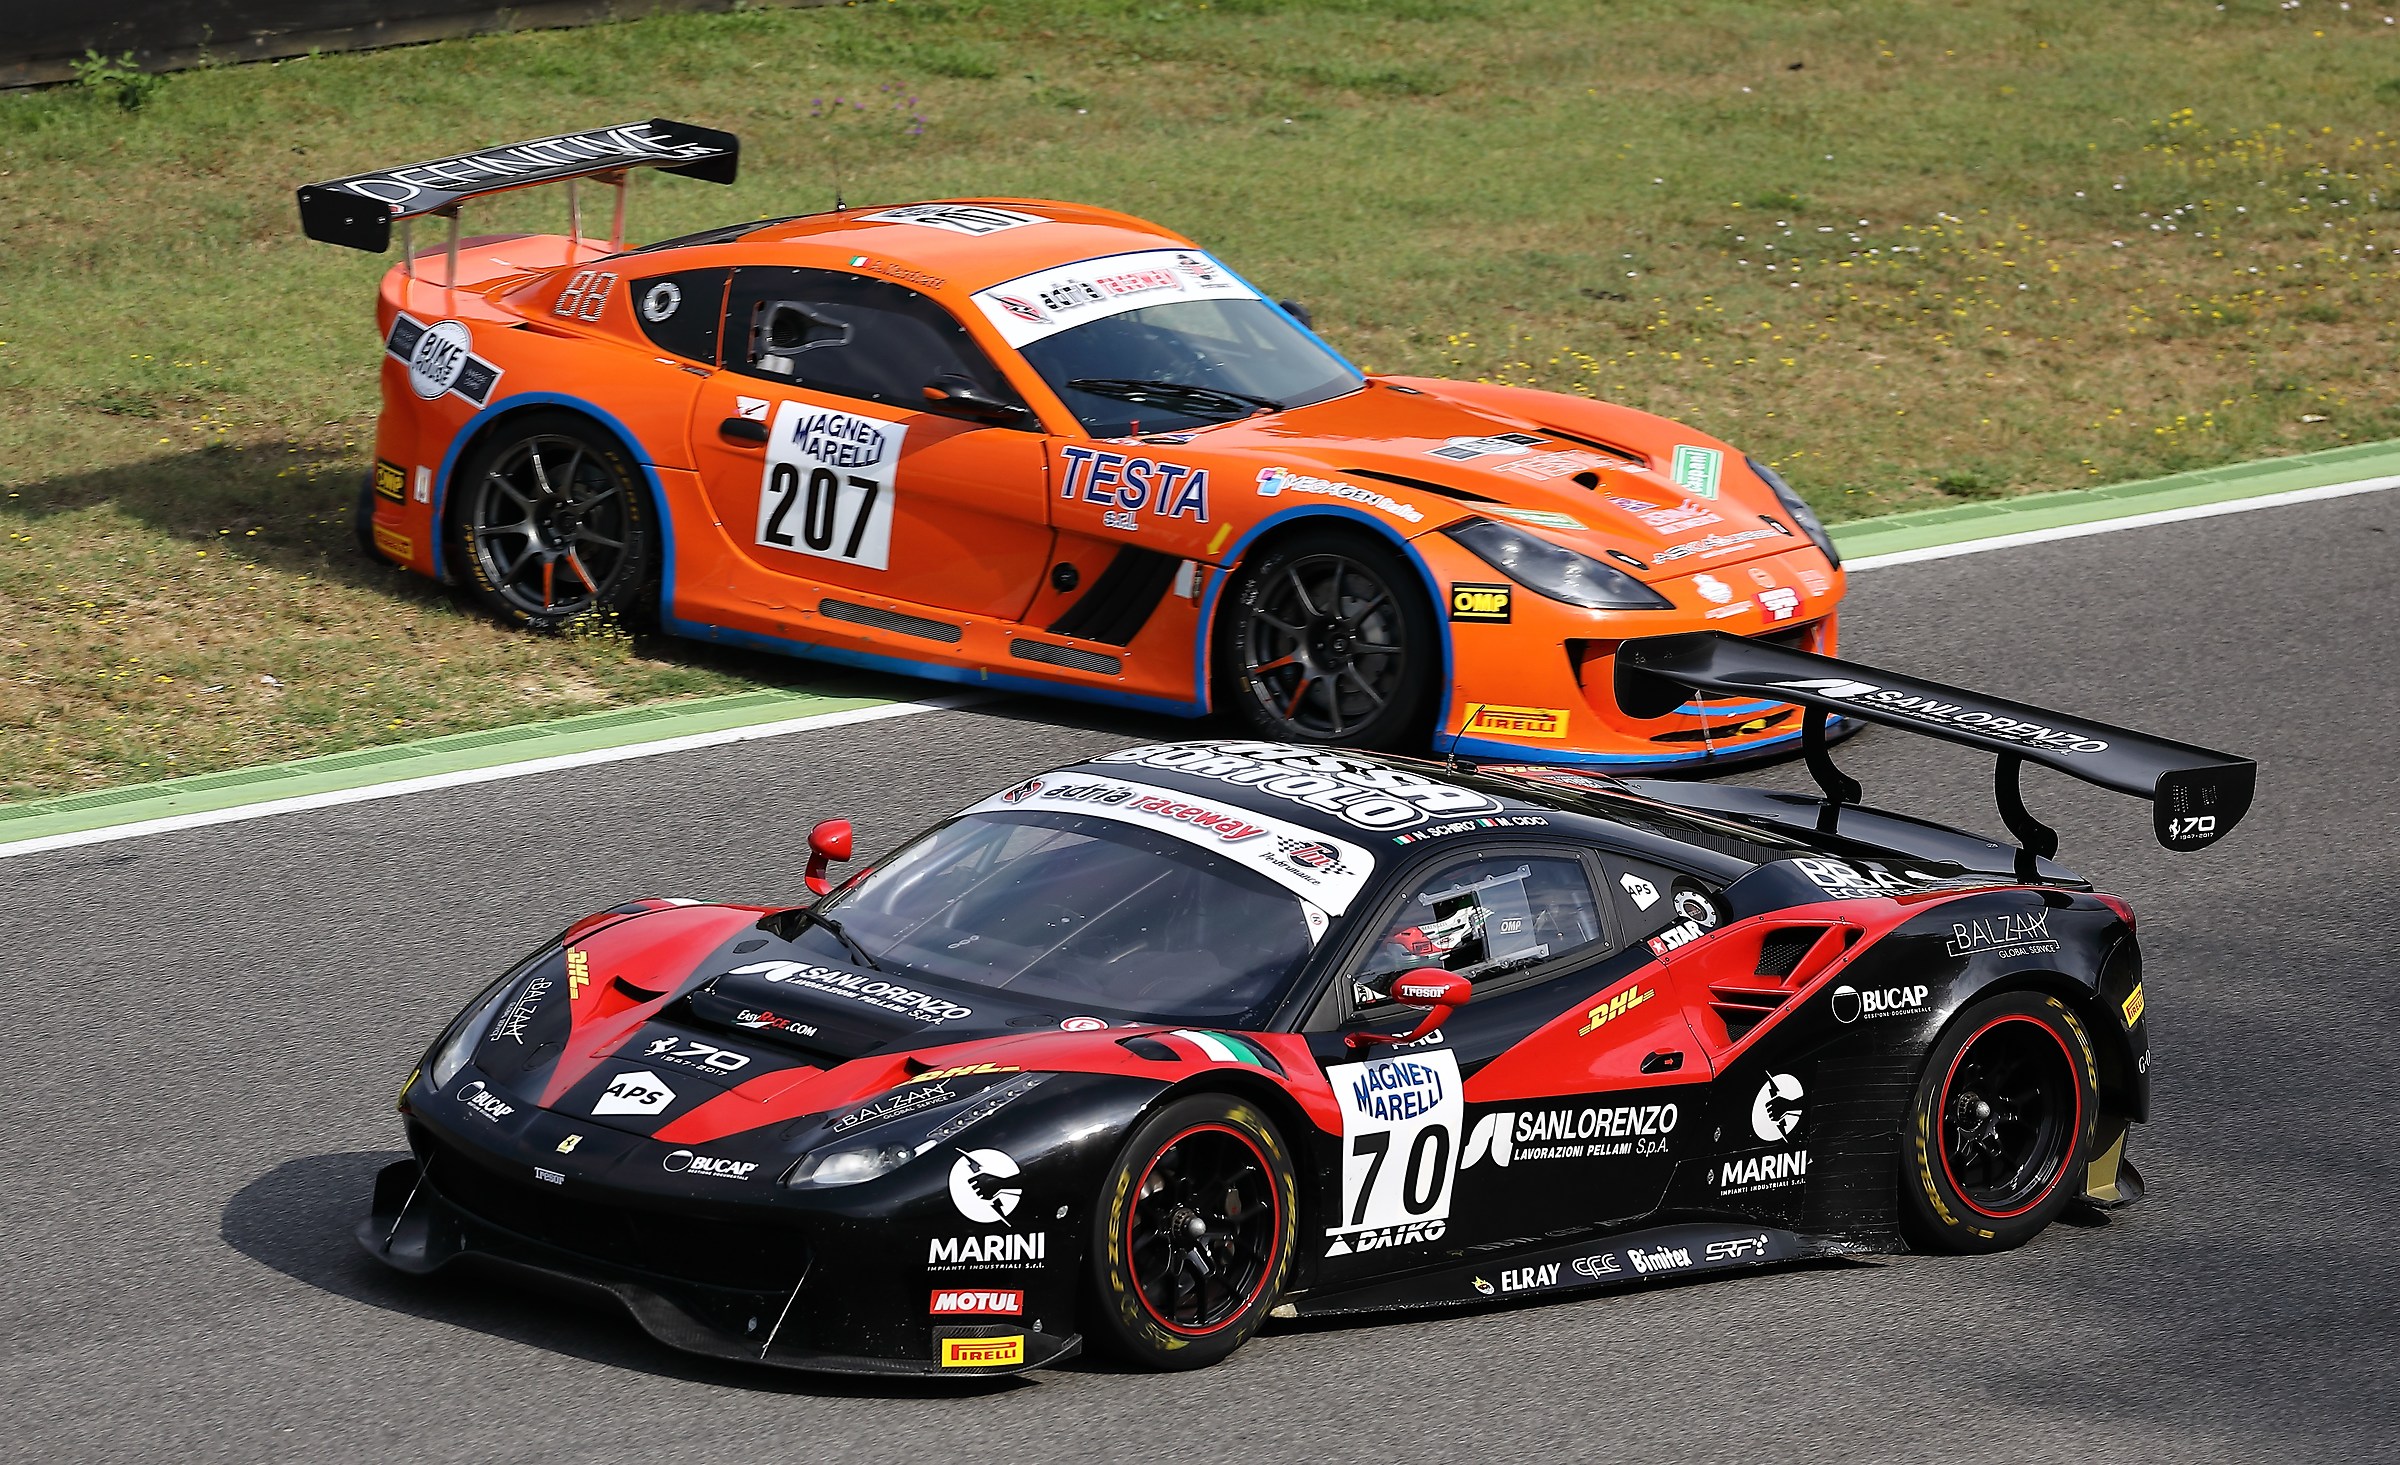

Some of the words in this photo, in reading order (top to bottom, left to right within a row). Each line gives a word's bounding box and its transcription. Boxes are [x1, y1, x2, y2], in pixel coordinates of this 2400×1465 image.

[343, 124, 699, 203] DEFINITIVE
[421, 332, 464, 371] BIKE
[793, 413, 886, 448] MAGNETI
[800, 430, 884, 467] MARELLI
[1061, 446, 1209, 523] TESTA
[764, 463, 880, 558] 207
[1454, 592, 1508, 612] OMP
[1475, 710, 1557, 733] PIRELLI
[1865, 691, 2109, 753] SANLORENZO
[1101, 746, 1417, 826] BORTOLO
[1046, 782, 1134, 804] adria
[1130, 796, 1267, 841] raceway
[1498, 817, 1513, 827] M.
[1514, 816, 1549, 826] CIOCI
[2182, 815, 2216, 834] 70
[1412, 831, 1429, 841] N.
[1628, 884, 1651, 897] APS
[1500, 920, 1521, 933] OMP
[1664, 921, 1705, 950] STAR
[1953, 907, 2048, 950] BALZAN
[1999, 947, 2029, 959] GLOBAL
[2030, 945, 2056, 955] SERVICE
[786, 977, 857, 999] LAVORAZIONI
[857, 995, 908, 1013] PELLAMI
[799, 966, 973, 1019] SANLORENZO
[1401, 984, 1449, 998] Tresor
[1862, 985, 1928, 1012] BUCAP
[502, 981, 553, 1044] BALZAN
[1584, 985, 1650, 1032] DHL
[670, 1041, 751, 1071] 70
[905, 1062, 1008, 1085] DHL
[1353, 1062, 1443, 1105] MAGNETI
[472, 1091, 514, 1117] BUCAP
[606, 1082, 664, 1106] APS
[842, 1078, 951, 1126] BALZAN
[883, 1106, 915, 1120] GLOBAL
[918, 1096, 949, 1109] SERVICE
[1361, 1088, 1443, 1121] MARELLI
[1516, 1103, 1678, 1142] SANLORENZO
[1514, 1145, 1583, 1161] LAVORAZIONI
[1587, 1143, 1632, 1157] PELLAMI
[1636, 1138, 1669, 1158] S.p.A.
[691, 1155, 755, 1175] BUCAP
[1351, 1124, 1450, 1226] 70
[1721, 1150, 1806, 1187] MARINI
[1721, 1187, 1748, 1196] IMPIANTI
[1750, 1181, 1789, 1191] INDUSTRIALI
[929, 1232, 1045, 1264] MARINI
[1356, 1220, 1446, 1253] DAIKO
[1627, 1246, 1693, 1273] Bimitex
[1501, 1263, 1562, 1292] ELRAY
[934, 1292, 1019, 1311] MOTUL
[951, 1342, 1017, 1361] PIRELLI
